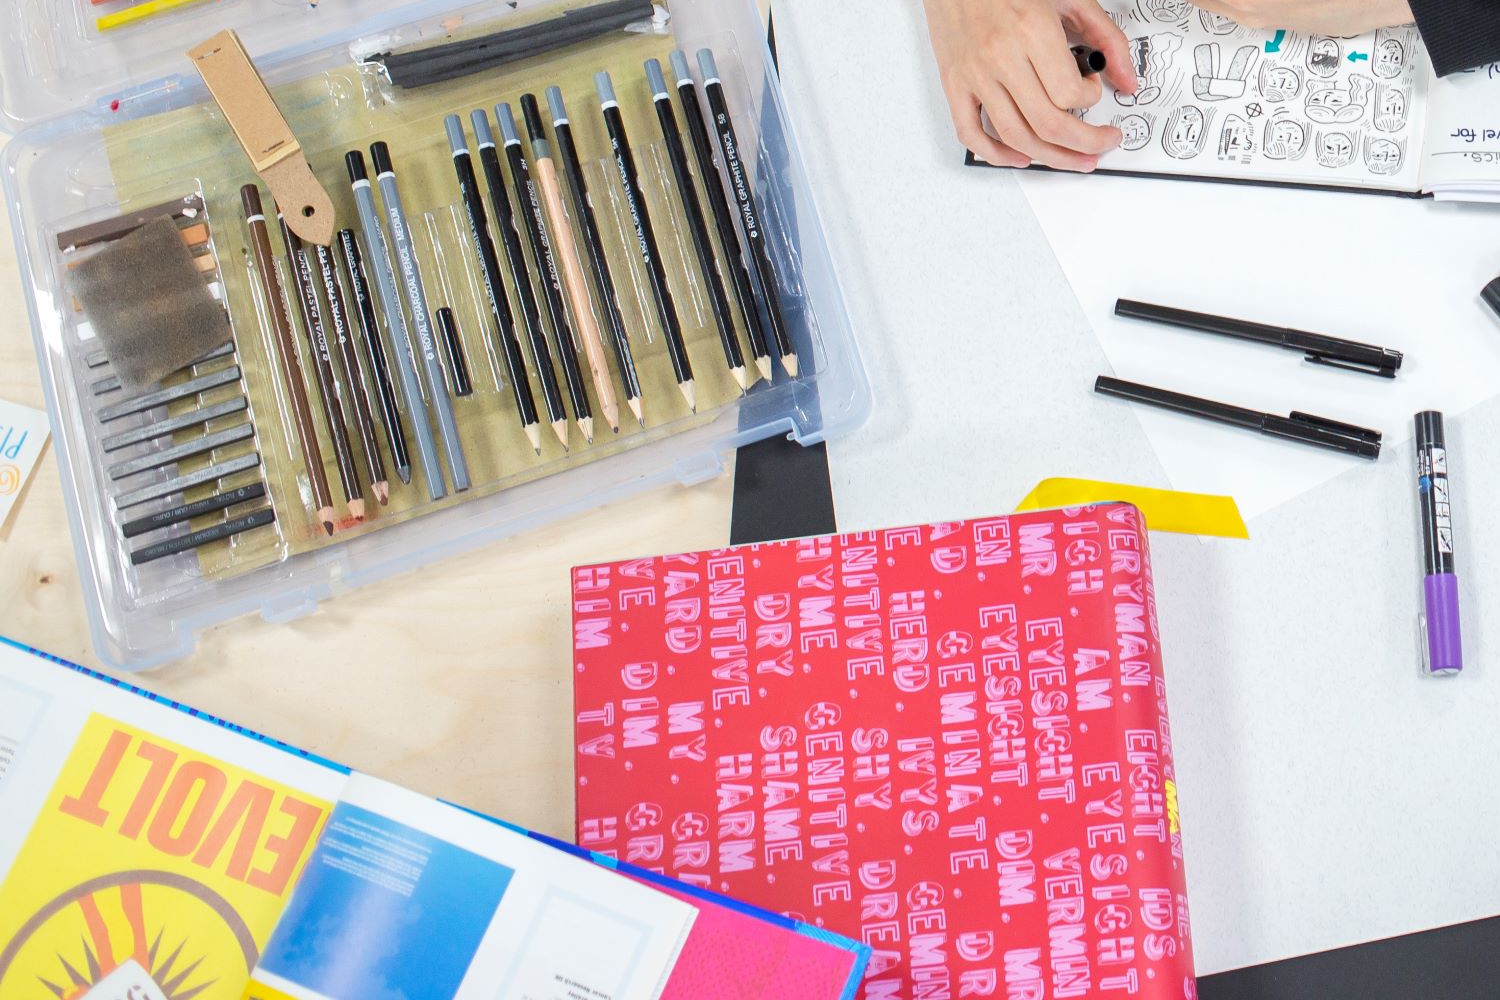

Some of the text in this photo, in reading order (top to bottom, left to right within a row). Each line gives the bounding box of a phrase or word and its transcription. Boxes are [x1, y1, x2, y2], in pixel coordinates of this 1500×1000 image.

[722, 130, 736, 159] PENCIL
[1450, 127, 1477, 140] for
[730, 159, 747, 200] GRAPHITE
[615, 154, 647, 253] ROYAL GRAPHITE PENCIL
[741, 200, 755, 228] ROYAL
[390, 206, 432, 350] ROYAL CHARCOAL PENCIL MEDIUM
[544, 248, 557, 280] ROYAL
[322, 264, 344, 333] ROYAL PASTEL
[59, 729, 325, 896] EVOLT
